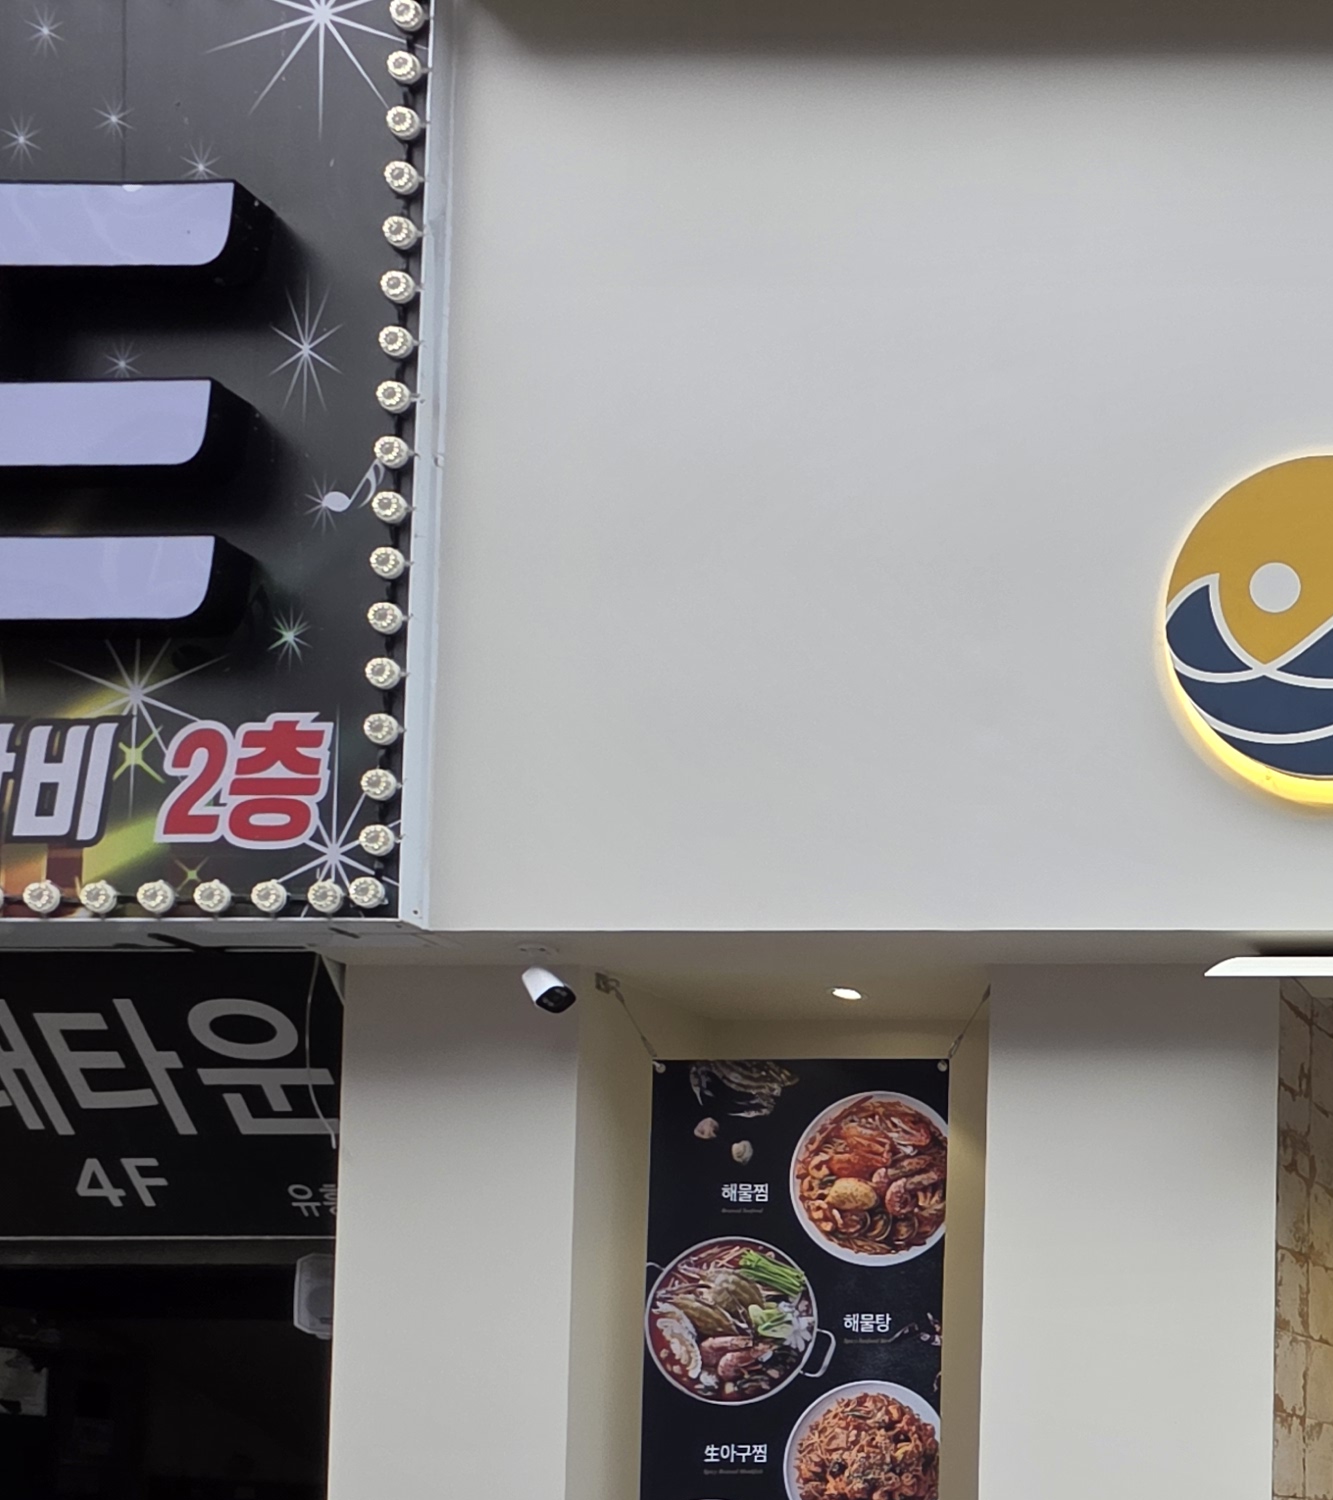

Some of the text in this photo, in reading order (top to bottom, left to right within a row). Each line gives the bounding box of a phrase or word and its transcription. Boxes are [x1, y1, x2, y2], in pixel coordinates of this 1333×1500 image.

[0, 714, 333, 848] 비 2층
[76, 1157, 168, 1207] 4F
[721, 1182, 769, 1202] 해물찜
[843, 1312, 892, 1333] 해물탕
[703, 1443, 768, 1463] 生아구찜
